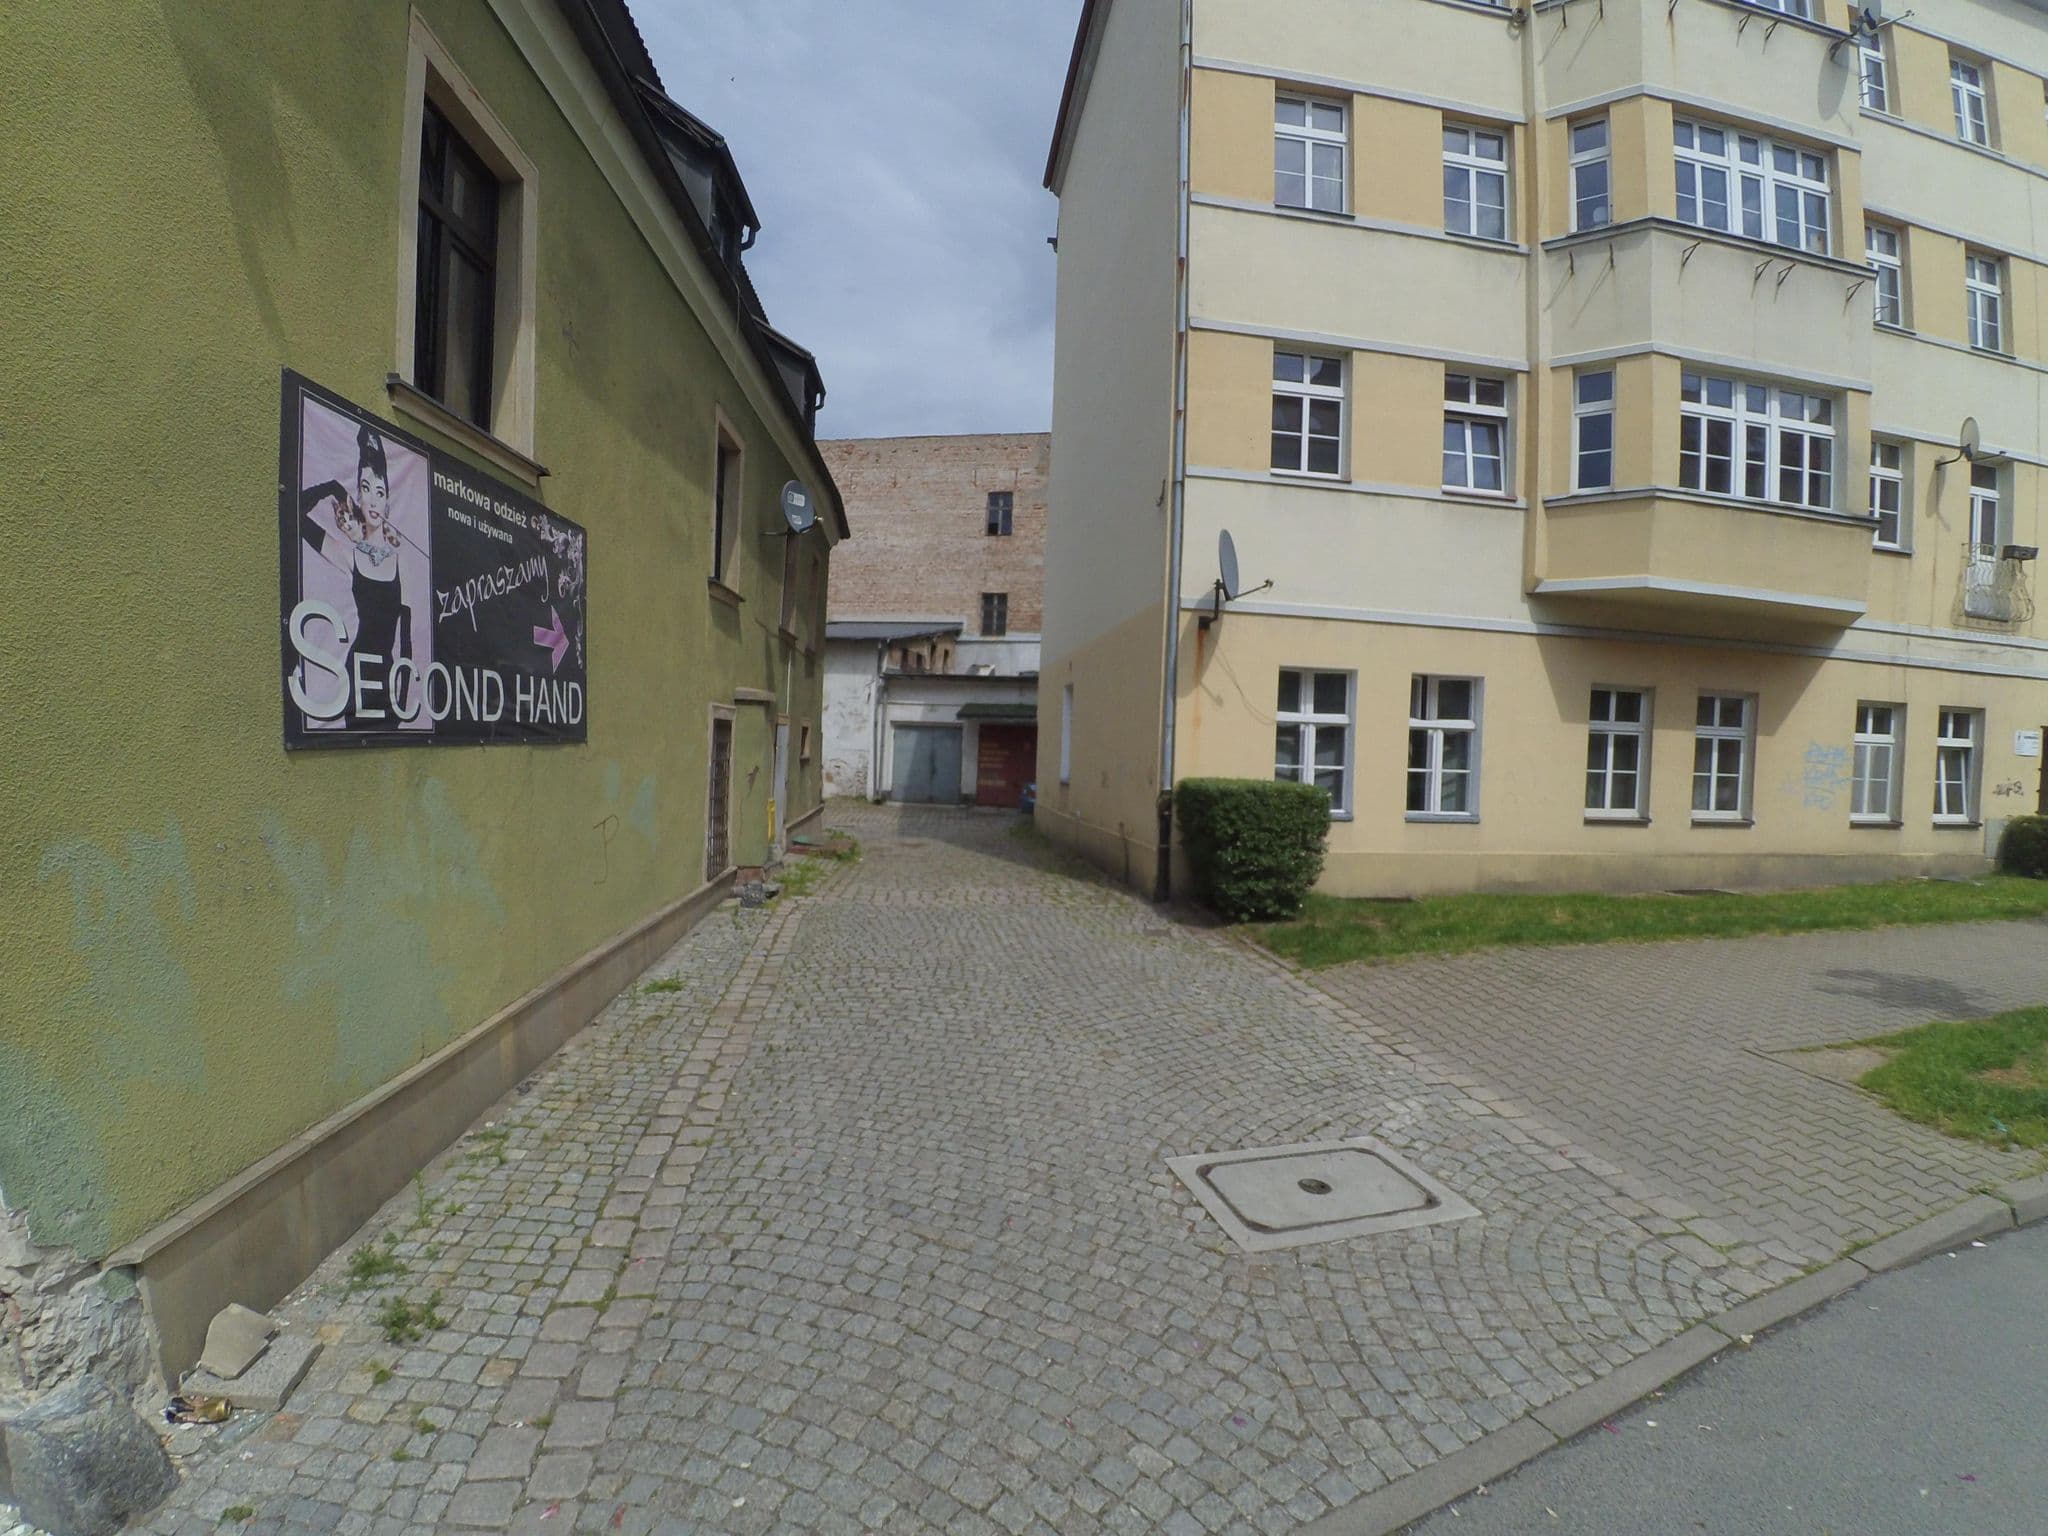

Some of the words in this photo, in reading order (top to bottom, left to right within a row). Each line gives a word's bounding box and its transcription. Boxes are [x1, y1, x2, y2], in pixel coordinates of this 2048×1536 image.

[433, 471, 491, 512] markowa
[493, 501, 527, 529] odzież
[447, 506, 472, 527] nowa
[473, 515, 477, 528] i
[478, 519, 513, 545] używana
[436, 555, 550, 633] zapraszamy
[288, 600, 505, 721] SECOND
[515, 674, 583, 725] HAND
